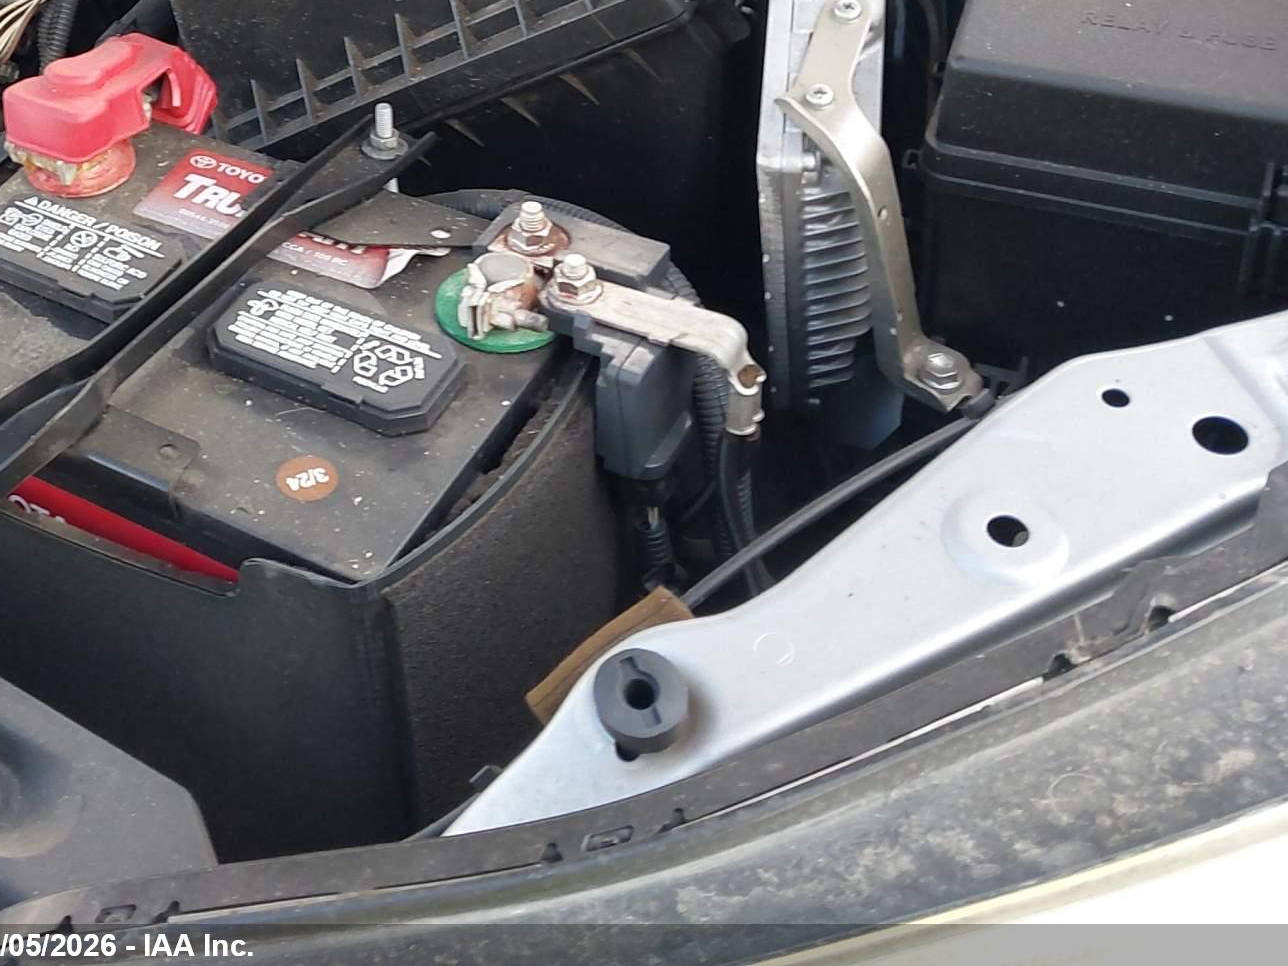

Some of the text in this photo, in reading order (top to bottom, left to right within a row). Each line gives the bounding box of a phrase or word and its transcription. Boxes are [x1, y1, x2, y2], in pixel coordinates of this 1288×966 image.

[217, 162, 266, 184] TOYO
[173, 173, 247, 217] TRU
[37, 199, 98, 227] DANGER
[106, 224, 163, 251] POISON
[285, 467, 330, 491] 3/24
